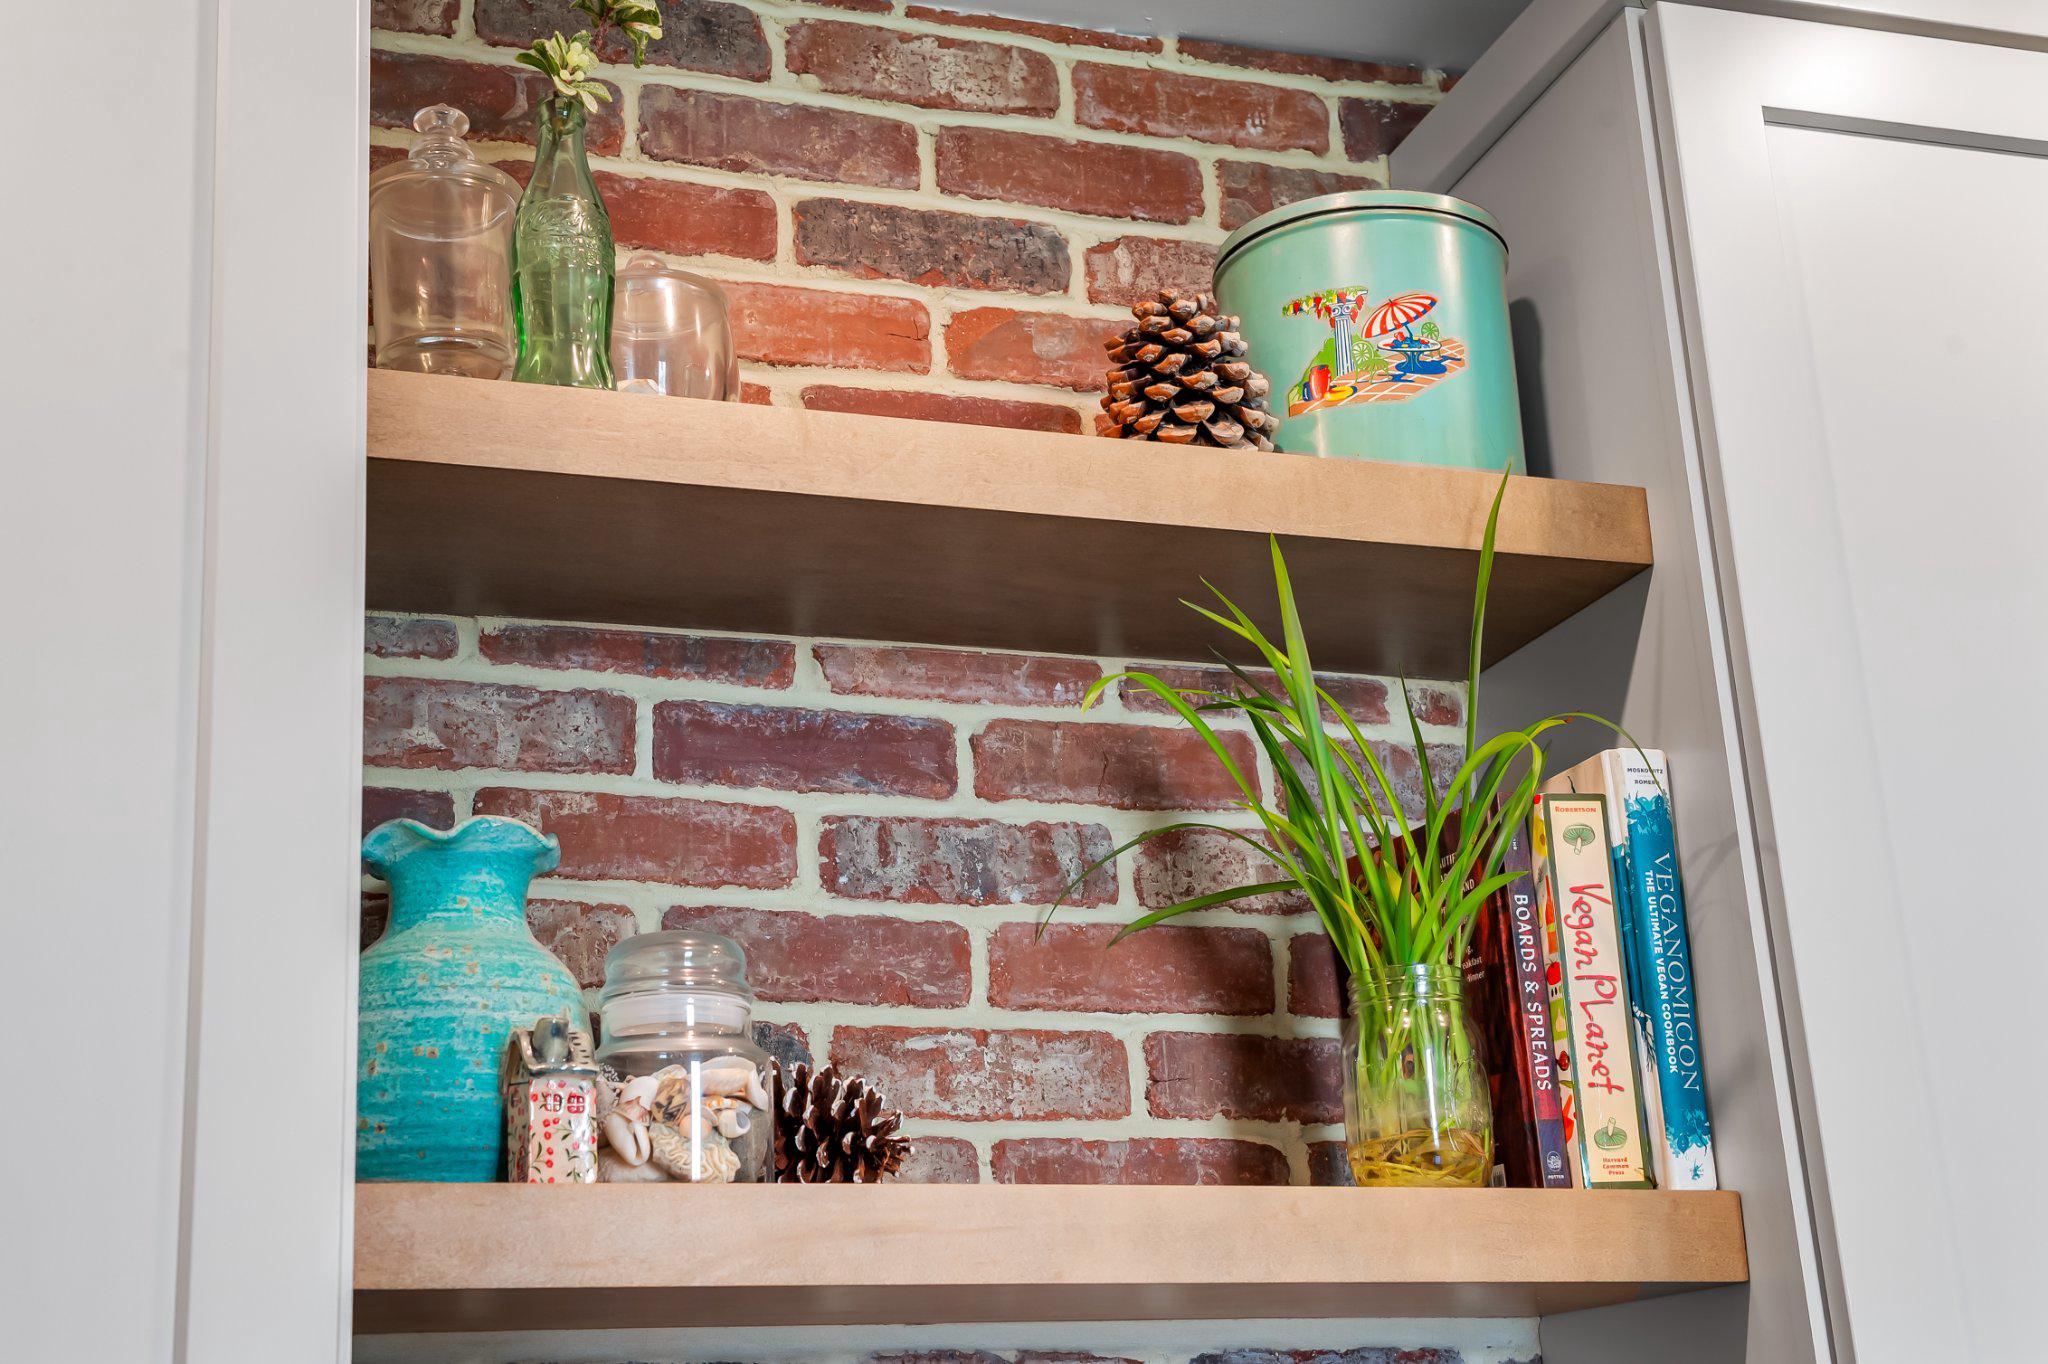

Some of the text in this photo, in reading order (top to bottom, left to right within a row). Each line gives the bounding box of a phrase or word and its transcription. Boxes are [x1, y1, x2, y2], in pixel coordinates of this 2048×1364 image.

[1554, 805, 1597, 813] ROBERTSON
[1626, 767, 1664, 775] MOSKOITZ
[1513, 894, 1551, 1091] BOARDS & SPREADS
[1563, 883, 1613, 970] Vegan
[1645, 870, 1679, 1074] THE ULTIMATE VEGAN COOKBOOK
[1654, 852, 1700, 1092] VEGANOMICON
